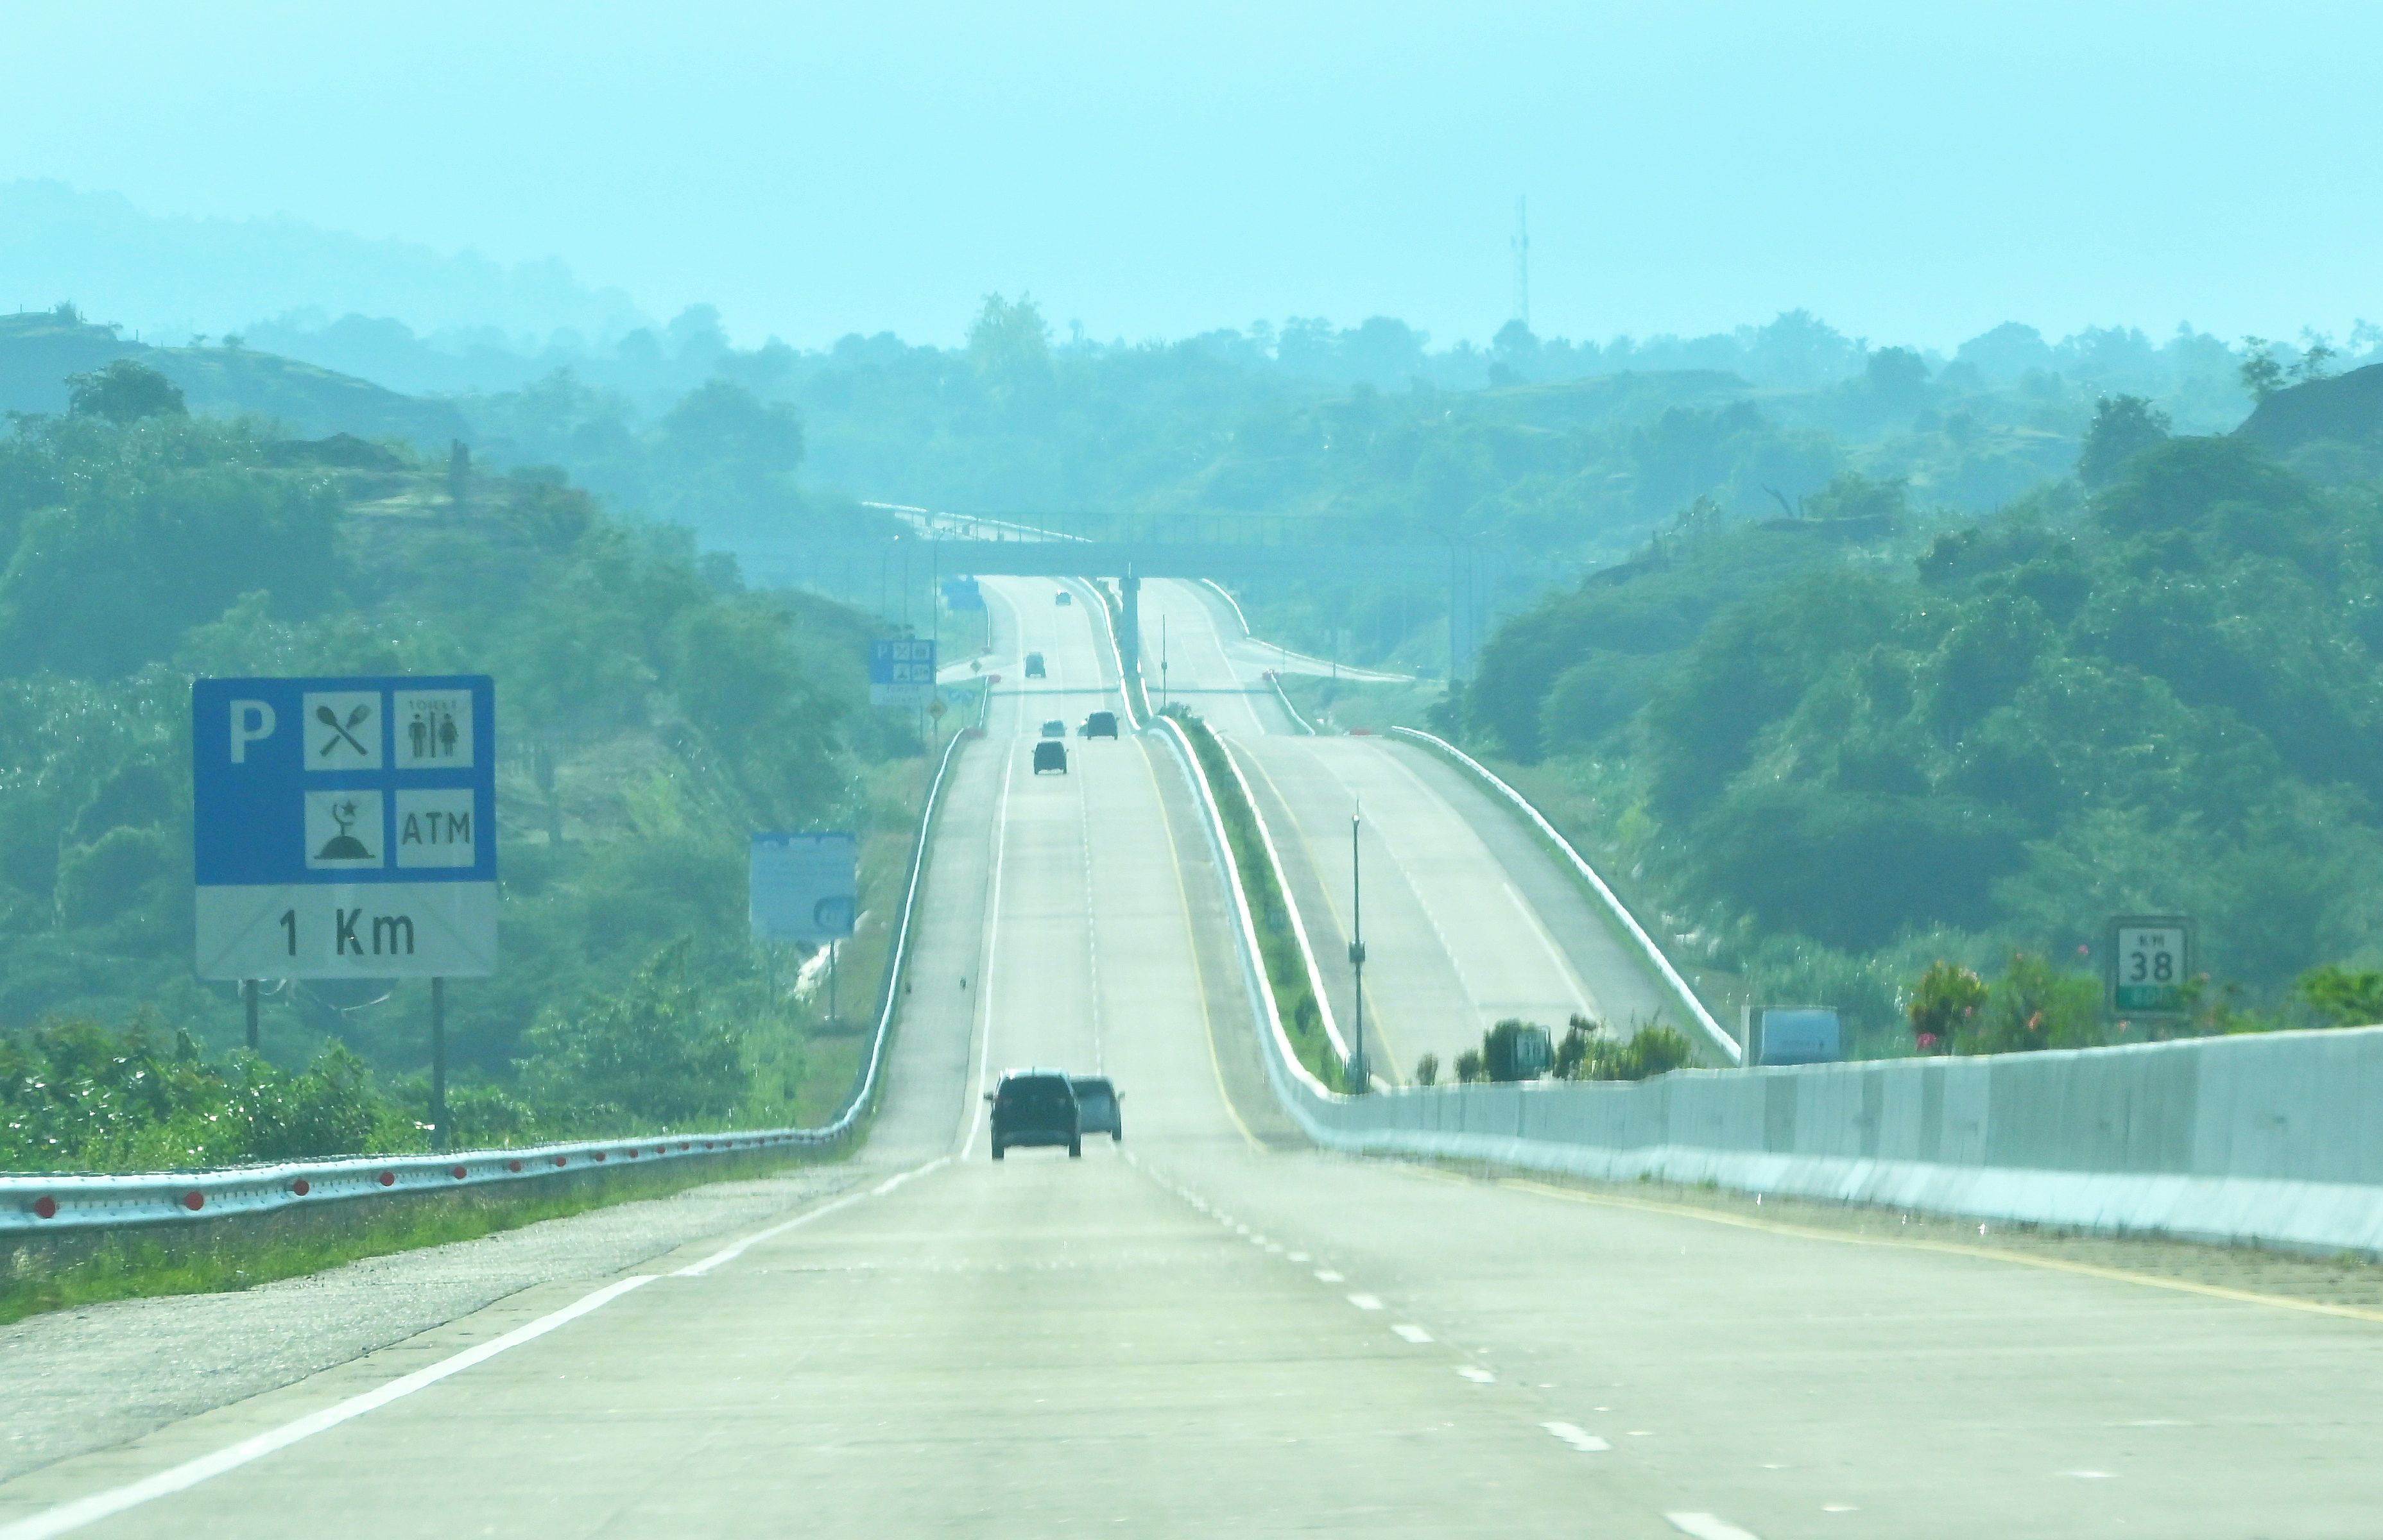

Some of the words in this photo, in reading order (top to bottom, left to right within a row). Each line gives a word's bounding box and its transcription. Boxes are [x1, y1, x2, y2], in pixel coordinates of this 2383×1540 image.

[229, 699, 277, 764] P
[402, 812, 470, 844] ATM
[280, 910, 296, 955] 1
[336, 909, 415, 955] Km
[2130, 951, 2173, 982] 38
